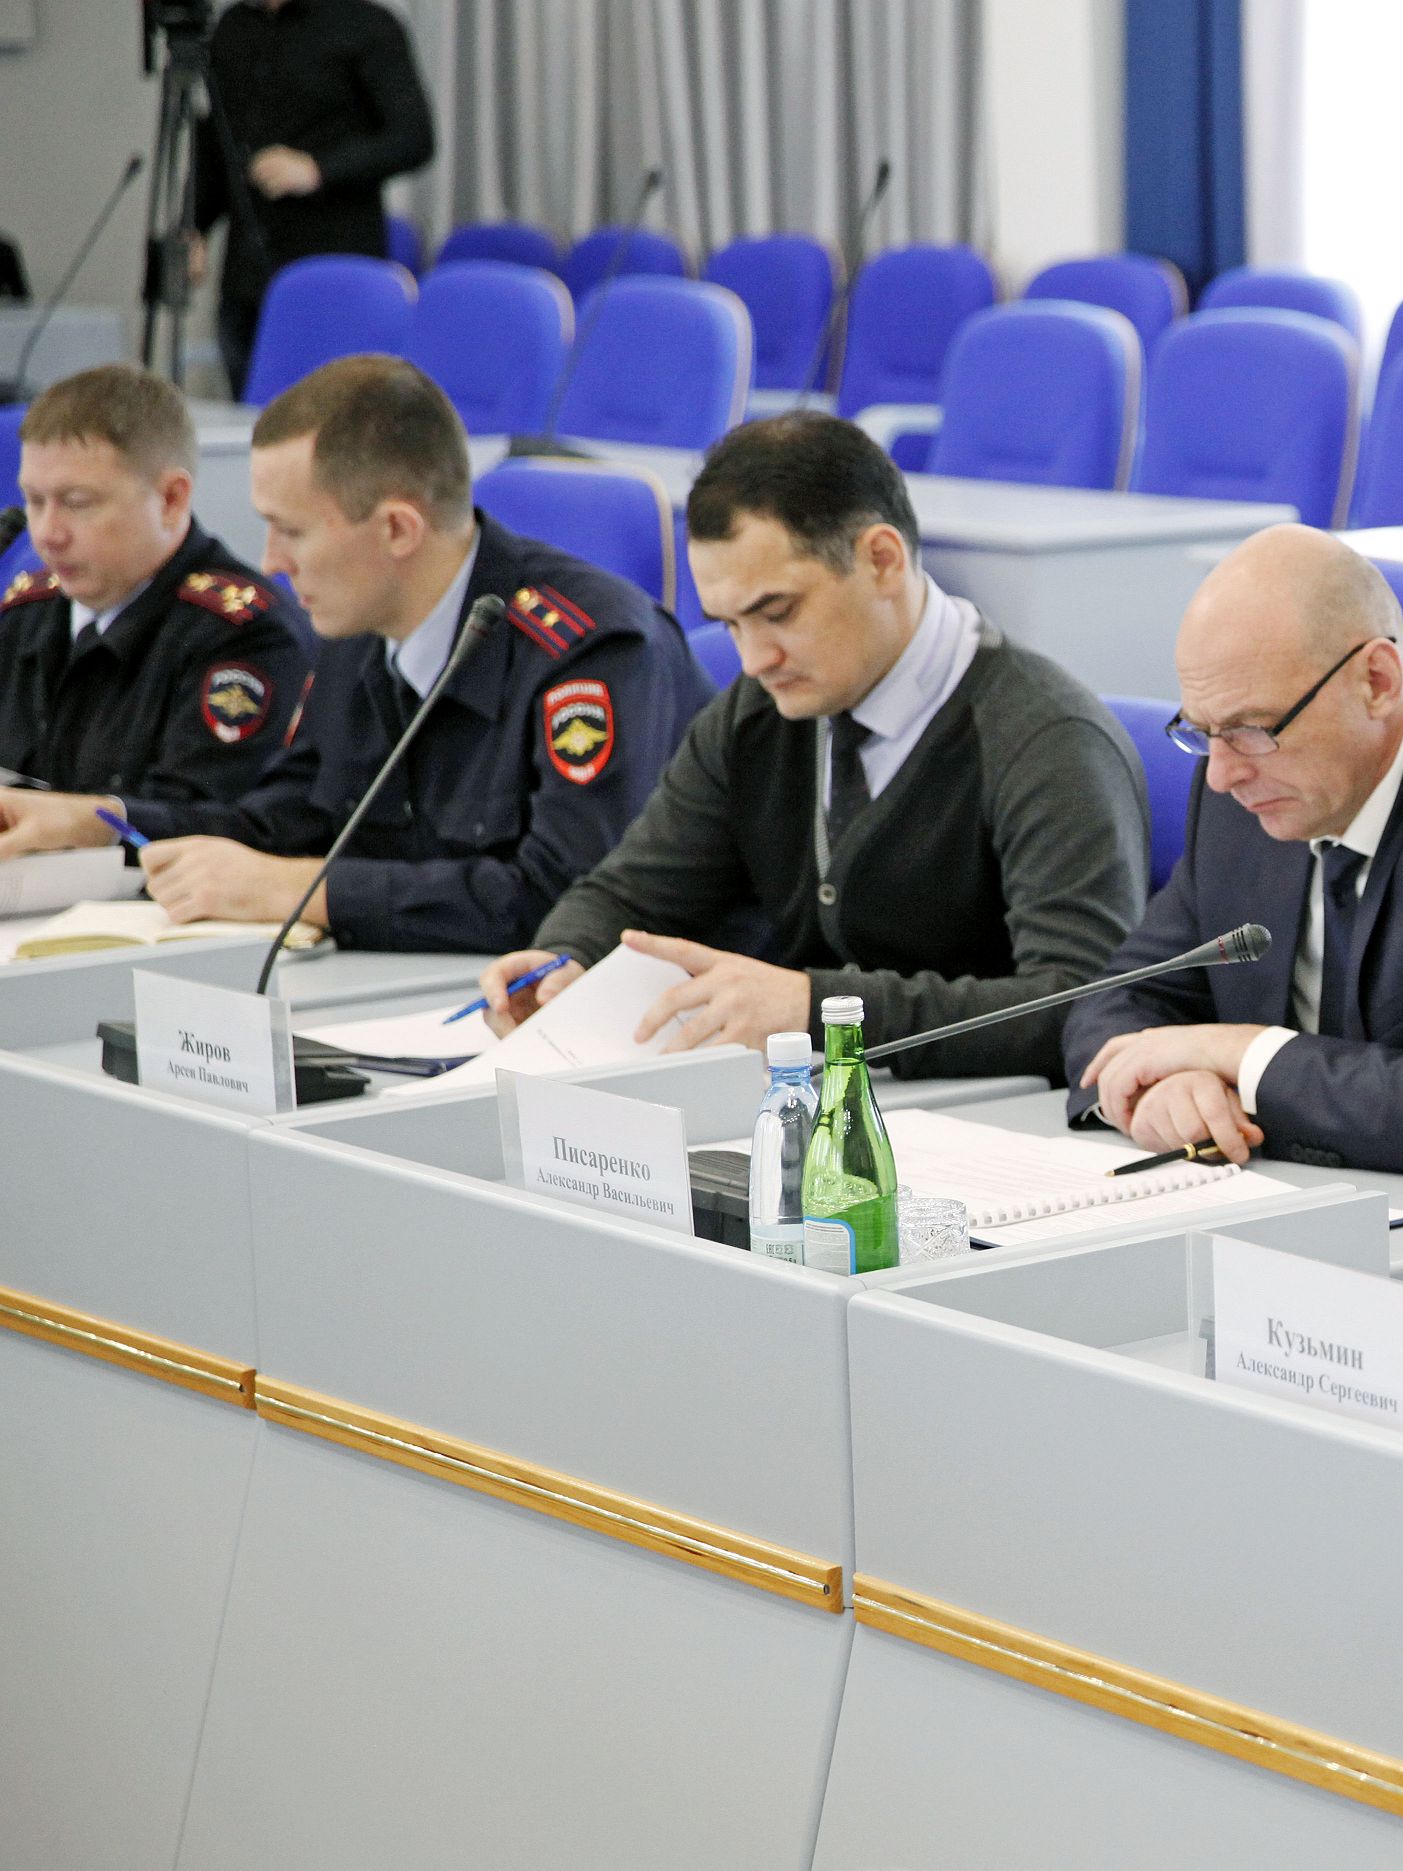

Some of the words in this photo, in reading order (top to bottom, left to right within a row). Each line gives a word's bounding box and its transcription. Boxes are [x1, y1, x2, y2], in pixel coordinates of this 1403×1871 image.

[178, 1029, 232, 1064] Жиров
[167, 1059, 196, 1080] Арсен
[199, 1066, 249, 1093] Павлович
[553, 1135, 651, 1181] Писаренко
[536, 1167, 600, 1200] Александр
[603, 1182, 675, 1215] Васильевич
[1266, 1317, 1364, 1370] Кузьмин
[1236, 1351, 1314, 1393] Александр
[1318, 1373, 1398, 1413] Сергеевич
